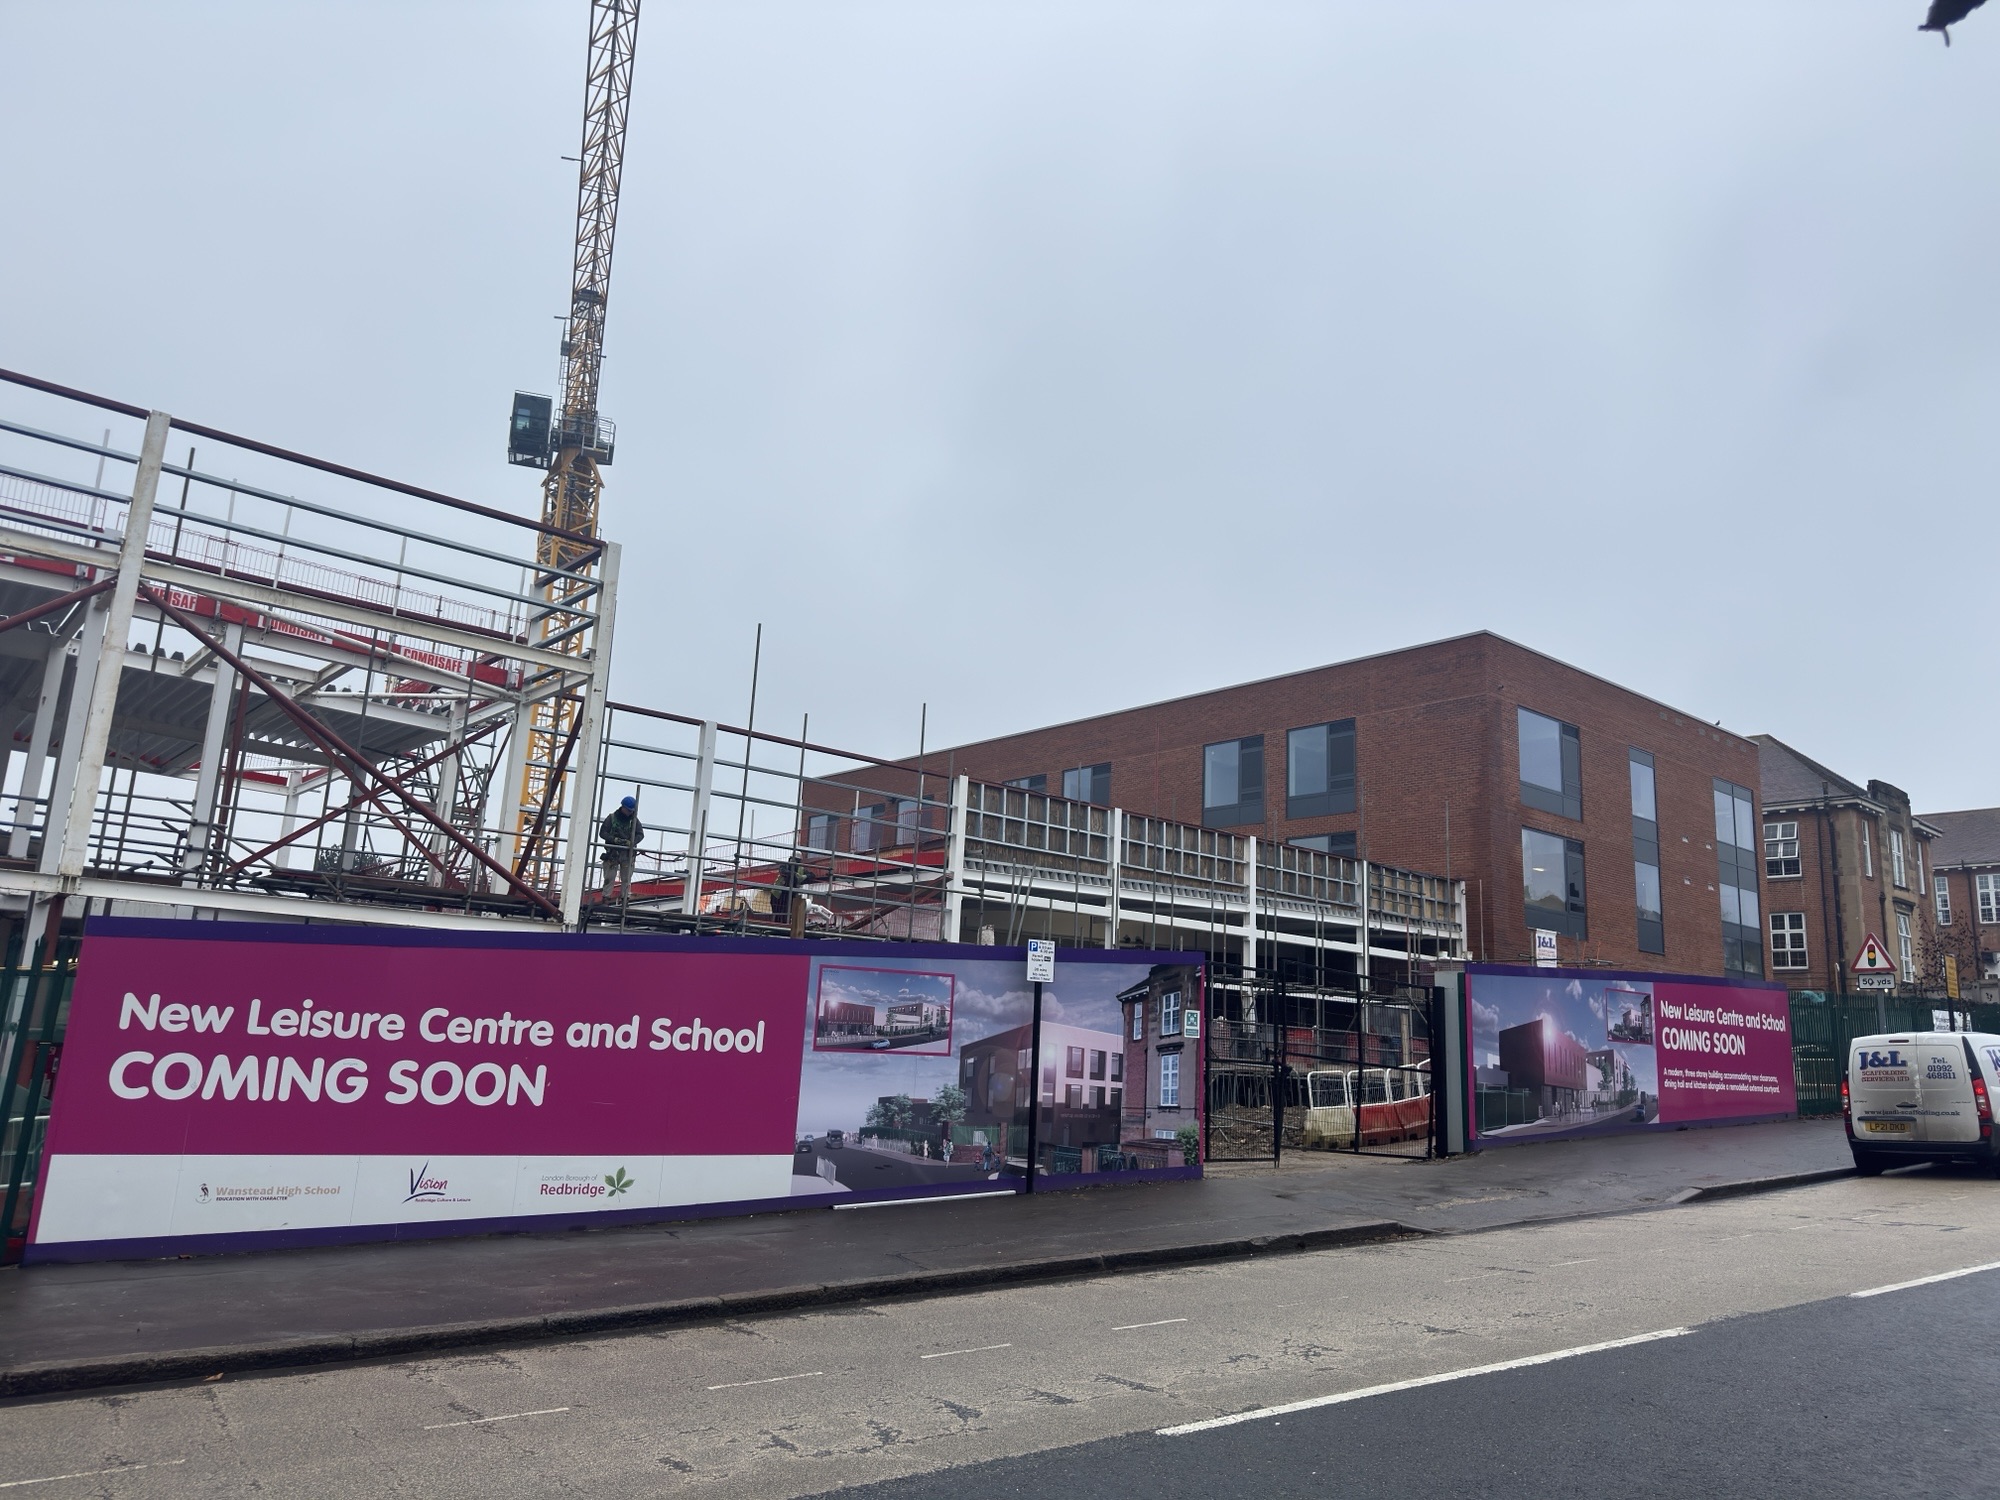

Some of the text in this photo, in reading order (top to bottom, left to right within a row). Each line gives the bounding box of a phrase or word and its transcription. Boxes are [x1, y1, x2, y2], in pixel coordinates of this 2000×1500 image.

[264, 619, 327, 641] OMBISAFE
[403, 648, 463, 673] COMBISAFE
[1031, 942, 1037, 951] P
[1537, 936, 1555, 949] J&L
[1862, 978, 1891, 986] 50 yds
[119, 992, 765, 1053] New Leisure Centre and School
[1660, 1000, 1786, 1032] New Leisure Centre and School
[1662, 1027, 1746, 1055] COMING SOON
[1859, 1050, 1908, 1070] J&L
[1986, 1049, 2000, 1072] J&
[1663, 1067, 1667, 1075] A
[1685, 1069, 1695, 1077] three
[1708, 1070, 1723, 1081] building
[1927, 1064, 1953, 1072] 01992
[109, 1051, 547, 1107] COMING SOON
[1685, 1080, 1693, 1088] and
[1869, 1122, 1888, 1131] LP21
[410, 1160, 448, 1195] Vision
[565, 1174, 590, 1182] Borough
[216, 1185, 341, 1197] Wanstead High School
[540, 1183, 605, 1198] Redbridge
